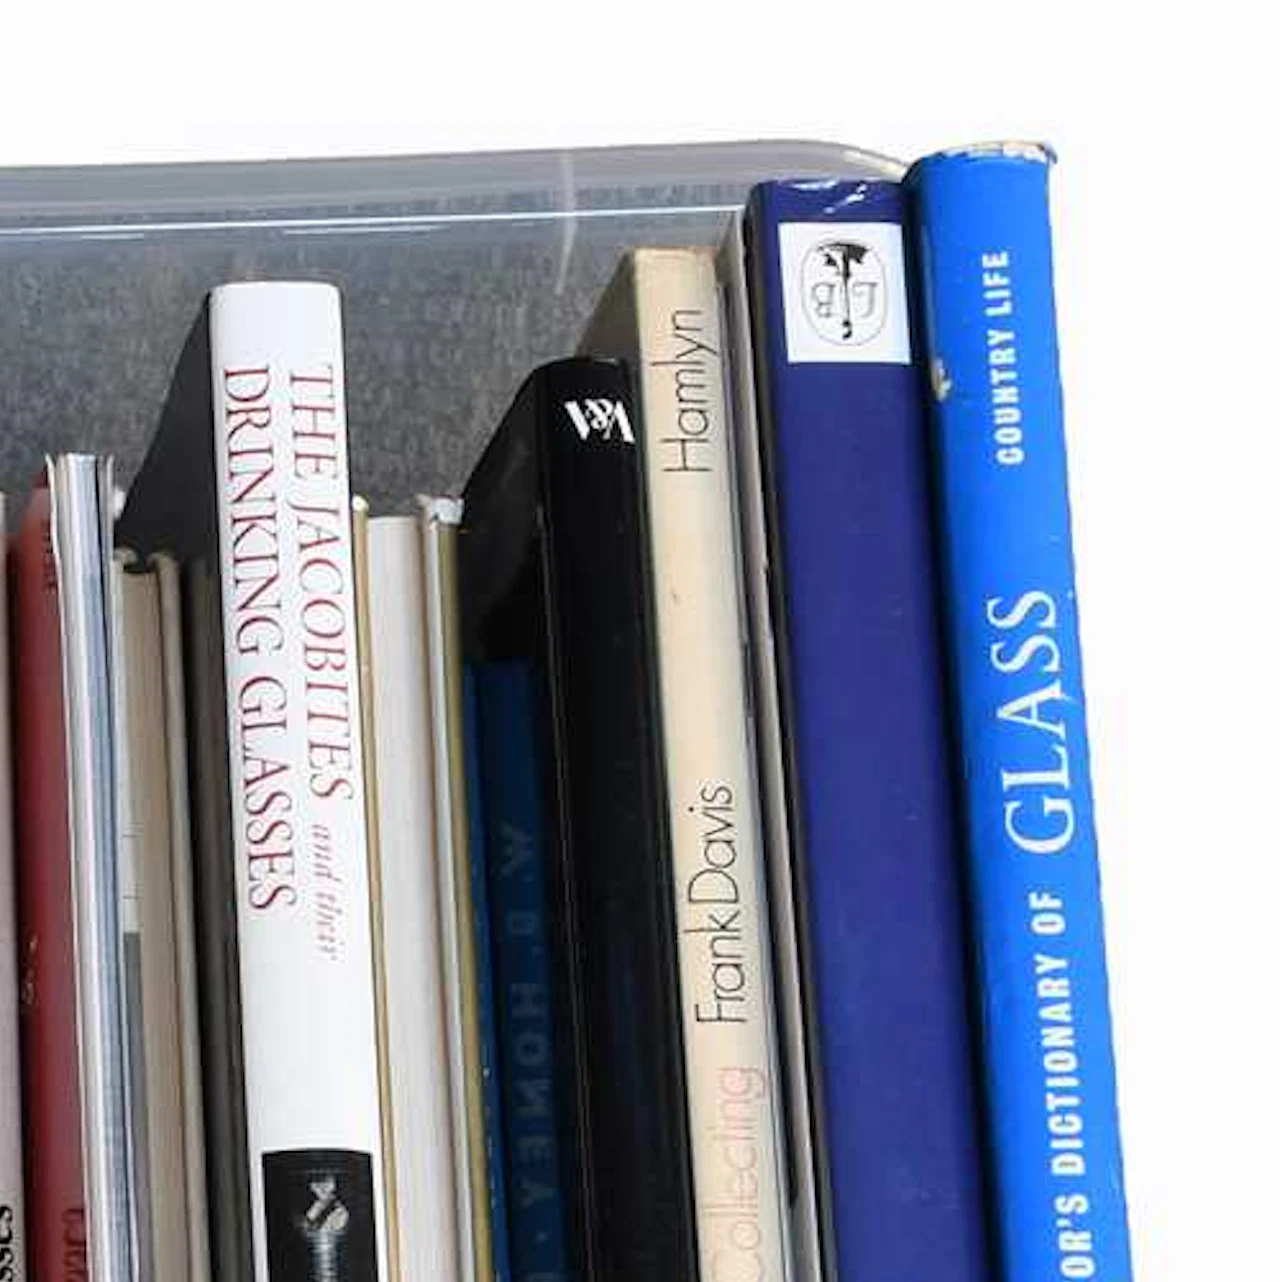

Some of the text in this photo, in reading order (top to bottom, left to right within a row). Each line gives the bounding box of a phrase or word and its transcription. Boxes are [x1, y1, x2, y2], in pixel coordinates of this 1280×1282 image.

[566, 398, 635, 443] V&A
[651, 309, 717, 473] Hamlyn
[982, 250, 1025, 465] COUNTRY LIFE
[224, 365, 297, 912] DRINKING GLASSES
[287, 365, 354, 962] THE JACOBITES and their
[986, 589, 1076, 854] GLASS
[688, 785, 740, 903] Davis
[1029, 892, 1066, 934] OF
[685, 910, 746, 1024] Frank
[1034, 954, 1087, 1174] DICTIONARY
